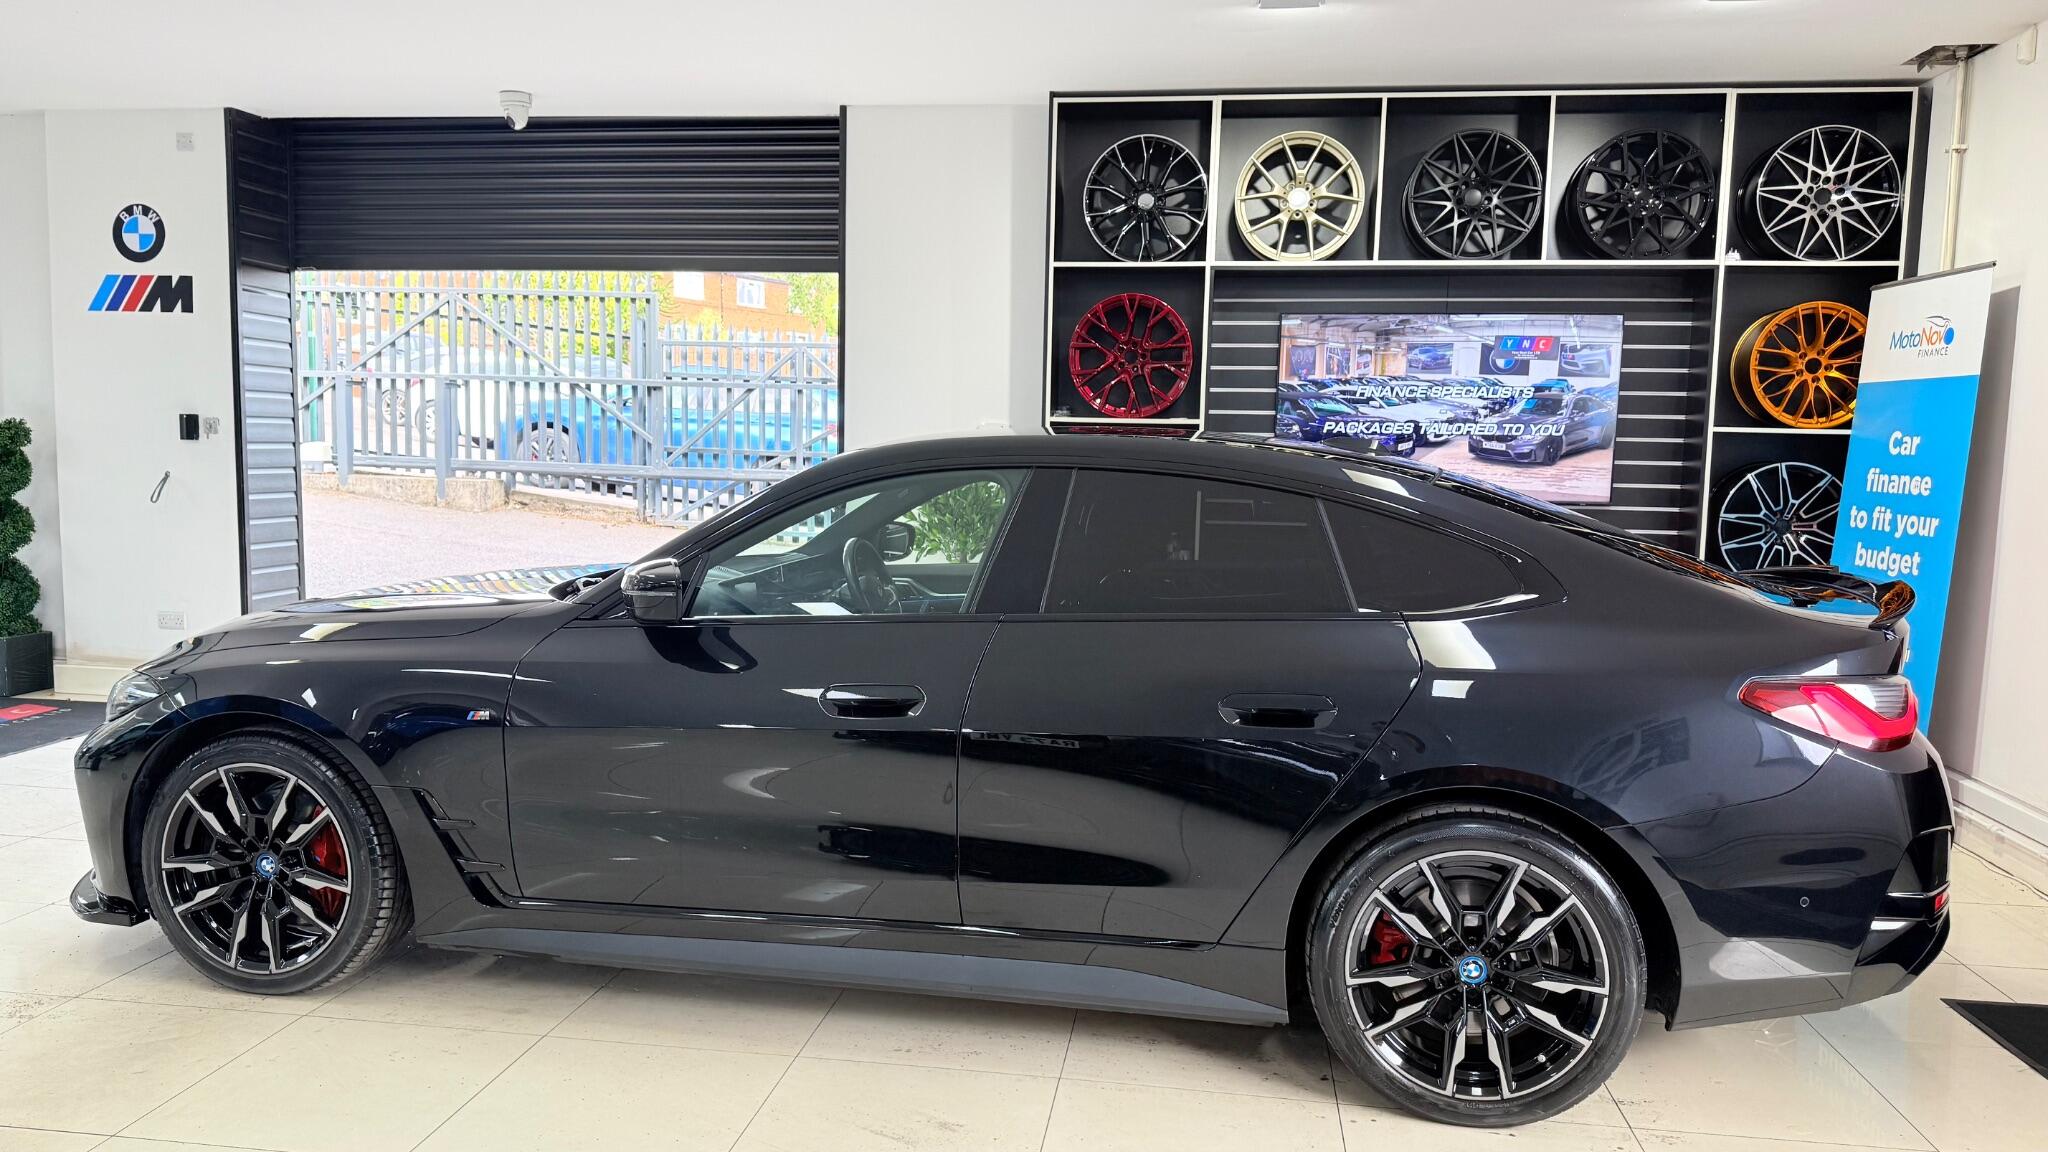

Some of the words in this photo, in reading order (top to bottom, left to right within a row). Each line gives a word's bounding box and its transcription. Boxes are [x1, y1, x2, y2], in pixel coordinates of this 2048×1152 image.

[119, 205, 160, 223] BMW
[1917, 346, 1949, 358] FINANCE
[1356, 385, 1428, 398] FINANCE
[1430, 386, 1535, 398] SPECIALISTS
[1323, 421, 1414, 434] PACKAGES
[1419, 422, 1497, 435] TAILORED
[1503, 423, 1524, 435] TO
[1530, 424, 1565, 436] YOU
[1888, 430, 1921, 456] Car
[1866, 467, 1932, 496] finance
[1849, 505, 1868, 529] to
[1871, 505, 1893, 532] fit
[1894, 513, 1940, 538] your
[1854, 541, 1921, 577] budget
